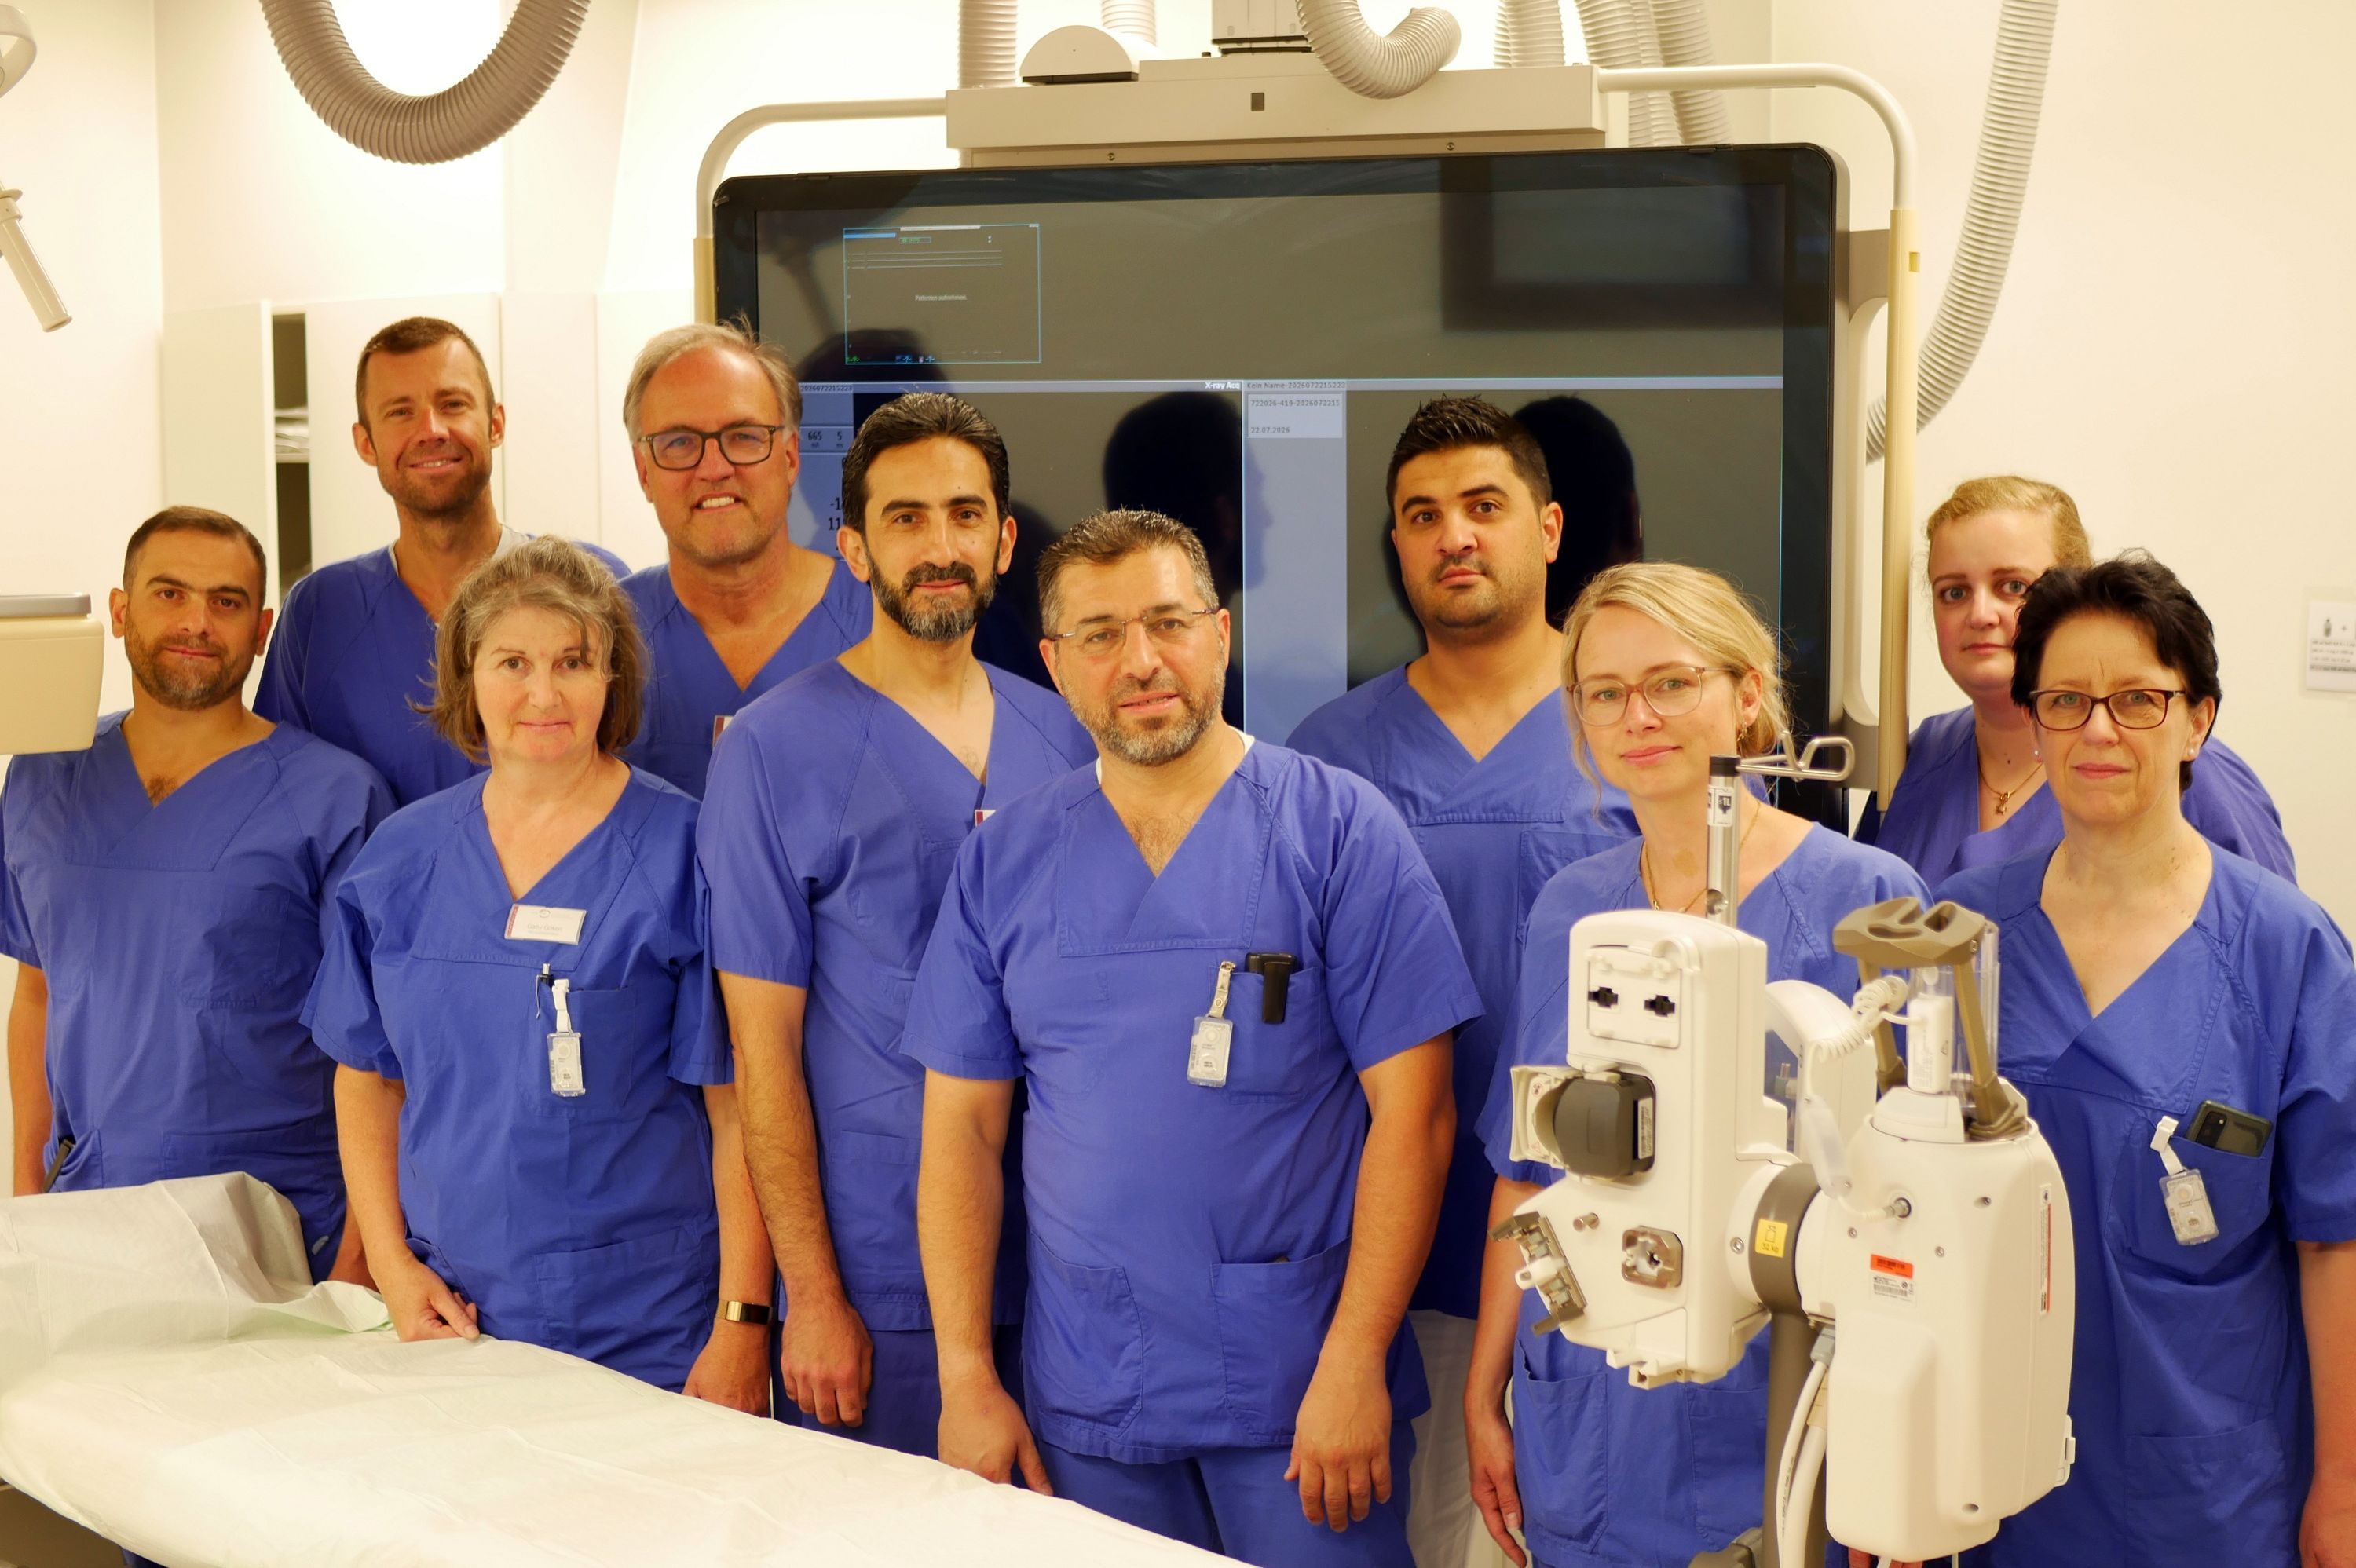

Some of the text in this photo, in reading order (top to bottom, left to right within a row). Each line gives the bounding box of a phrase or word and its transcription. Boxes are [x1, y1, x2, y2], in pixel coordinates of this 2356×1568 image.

[1205, 382, 1240, 390] X-ray Acq
[836, 431, 843, 440] 5
[828, 517, 843, 531] 11
